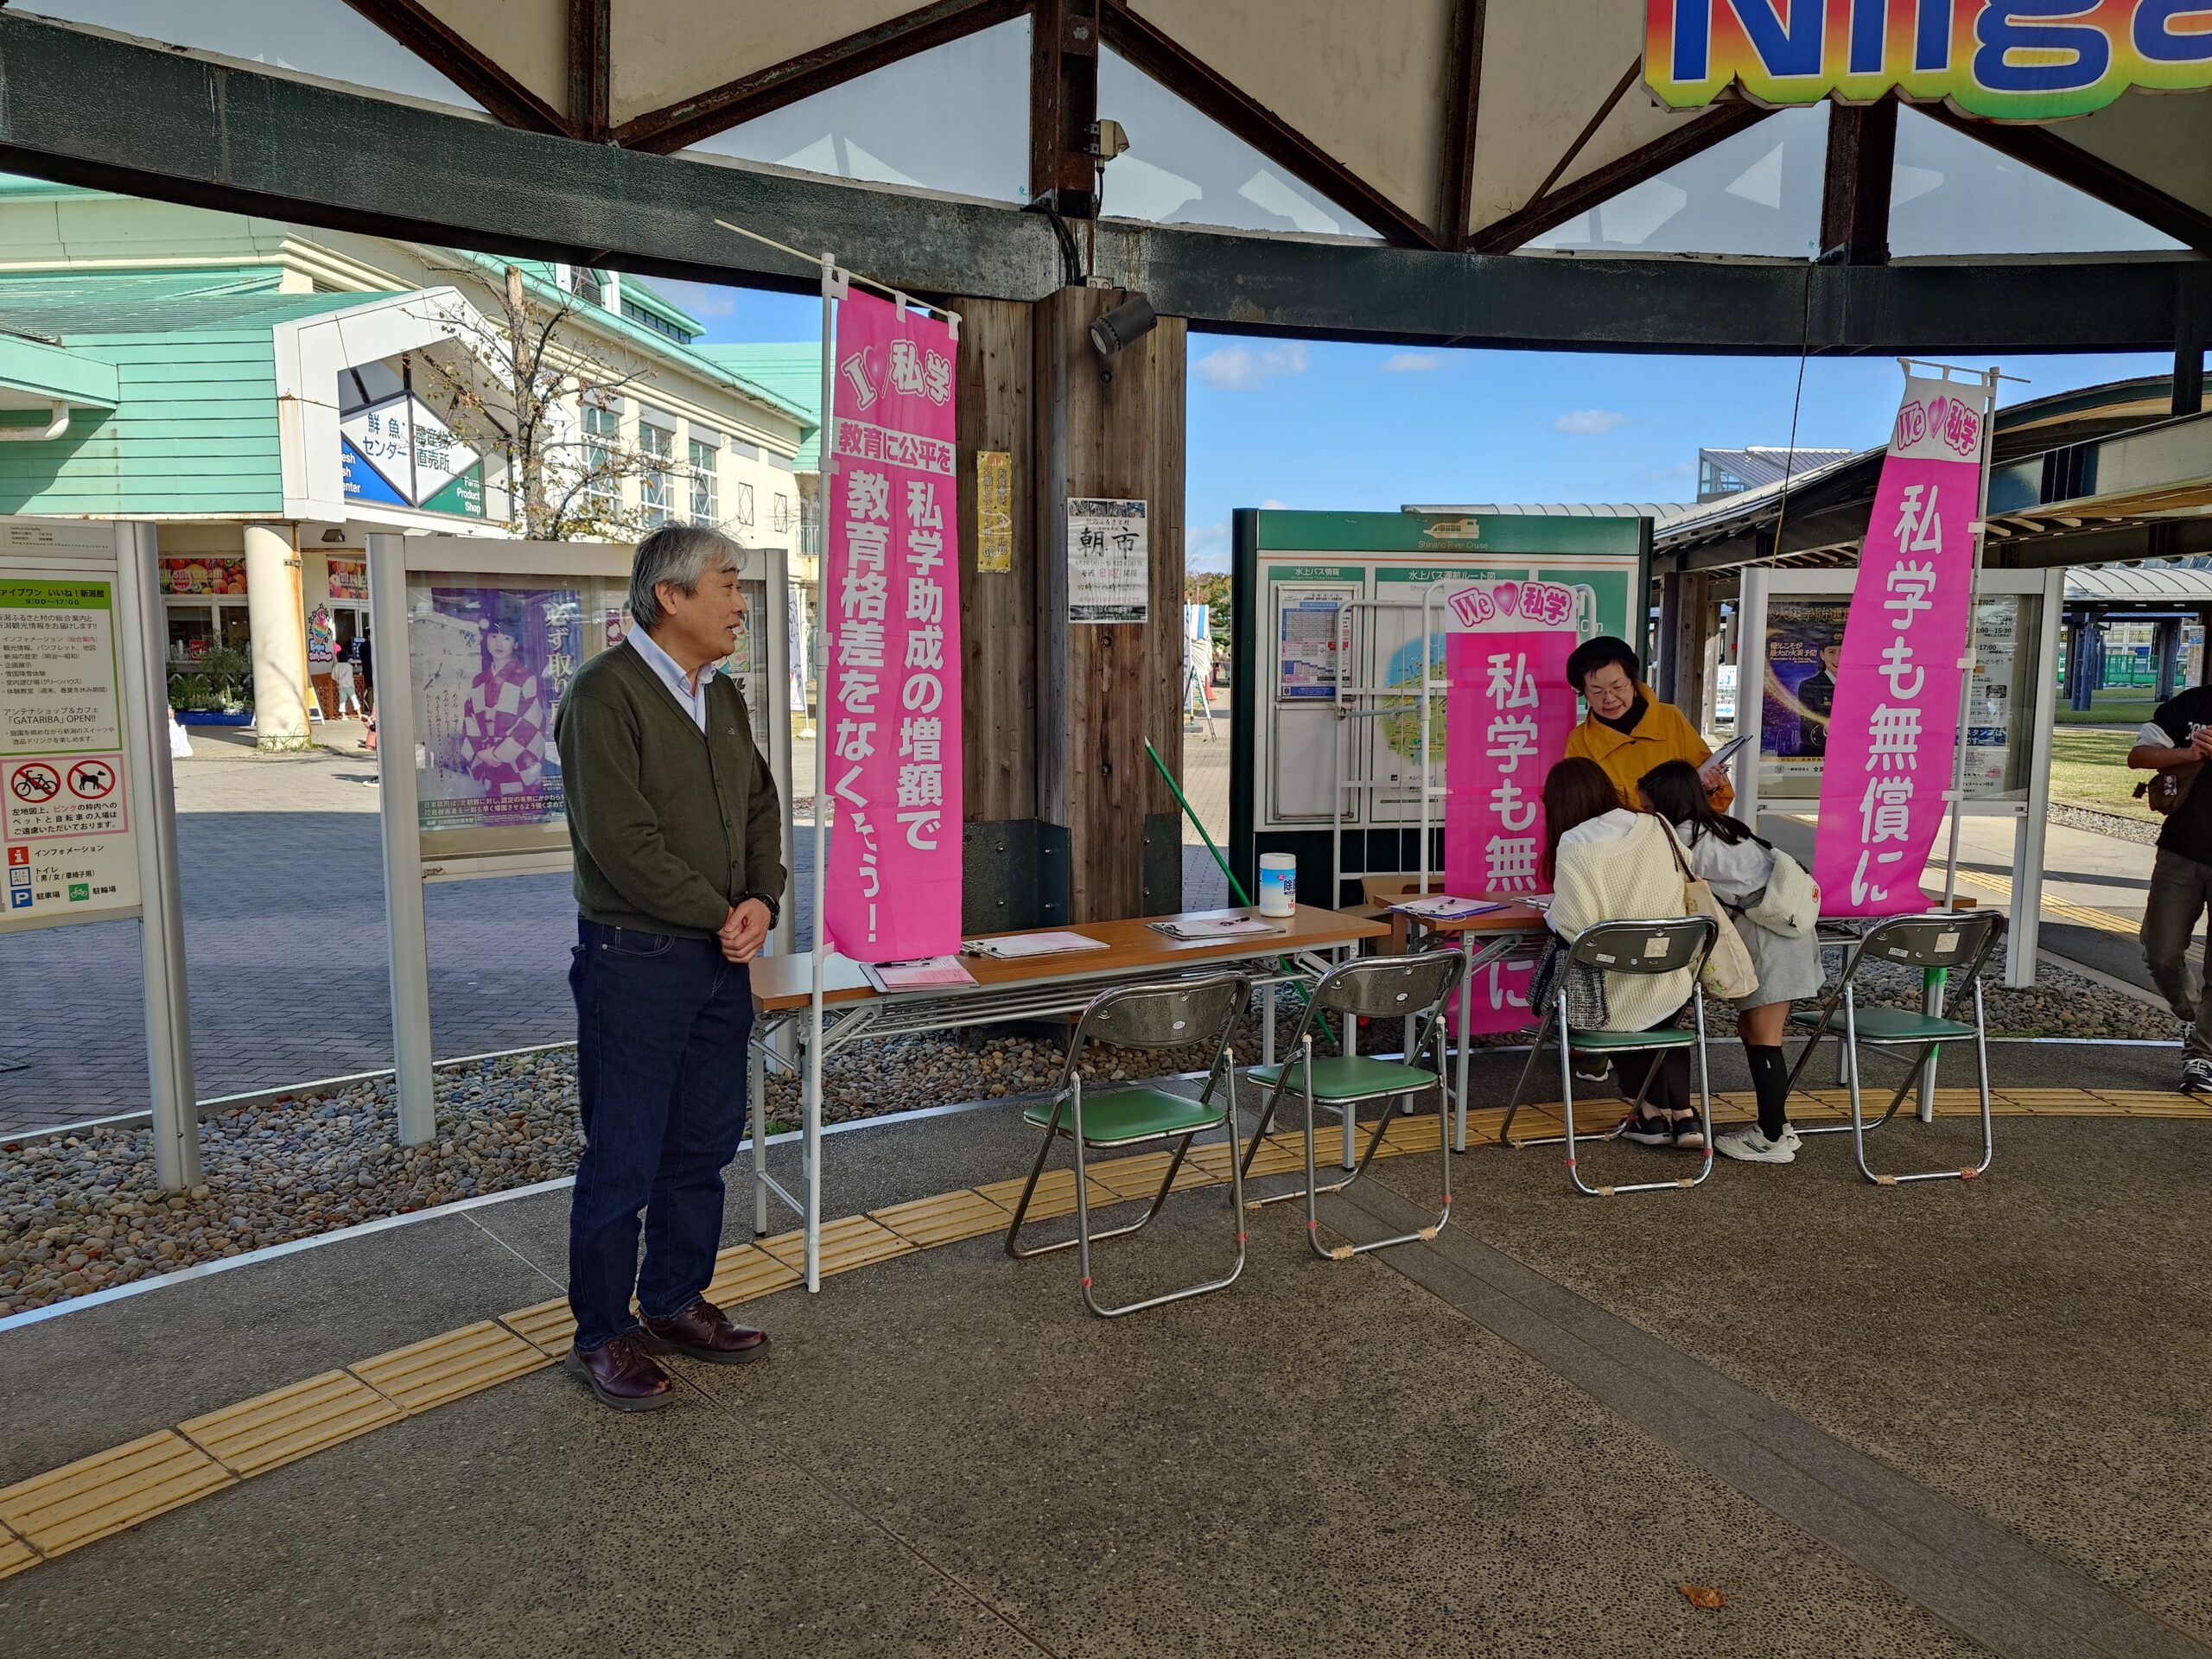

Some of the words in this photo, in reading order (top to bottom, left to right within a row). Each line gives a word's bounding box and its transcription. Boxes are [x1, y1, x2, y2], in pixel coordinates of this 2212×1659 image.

[842, 354, 876, 410] I
[890, 340, 950, 405] 私学
[1897, 406, 1925, 448] We
[1946, 401, 1979, 453] 私学
[363, 435, 407, 460] センター
[839, 422, 950, 473] 教育に公平を
[416, 448, 450, 472] 直売所
[456, 488, 480, 500] Product
[464, 477, 480, 488] Farm
[465, 502, 480, 515] Shop
[1077, 526, 1141, 560] 朝市
[1418, 541, 1446, 550] Shinano
[1447, 541, 1465, 550] River
[1466, 541, 1489, 550] Cruise
[1295, 568, 1339, 576] 水上バス情報
[1408, 570, 1496, 581] 水上バス運航ルート図
[1521, 584, 1569, 624] 私学
[896, 480, 946, 851] 私学助成の増額で
[832, 467, 891, 944] 教育格差をなくそう！
[1850, 484, 1943, 907] 私学も無償に
[12, 802, 118, 816] 左地図上、ピンクの枠内への
[14, 821, 116, 836] ご遠慮いただいております。
[1485, 652, 1540, 1010] 私学も無に
[35, 845, 105, 857] インフォメーション
[35, 891, 60, 900] 駐車場
[92, 885, 117, 895] 駐輪場
